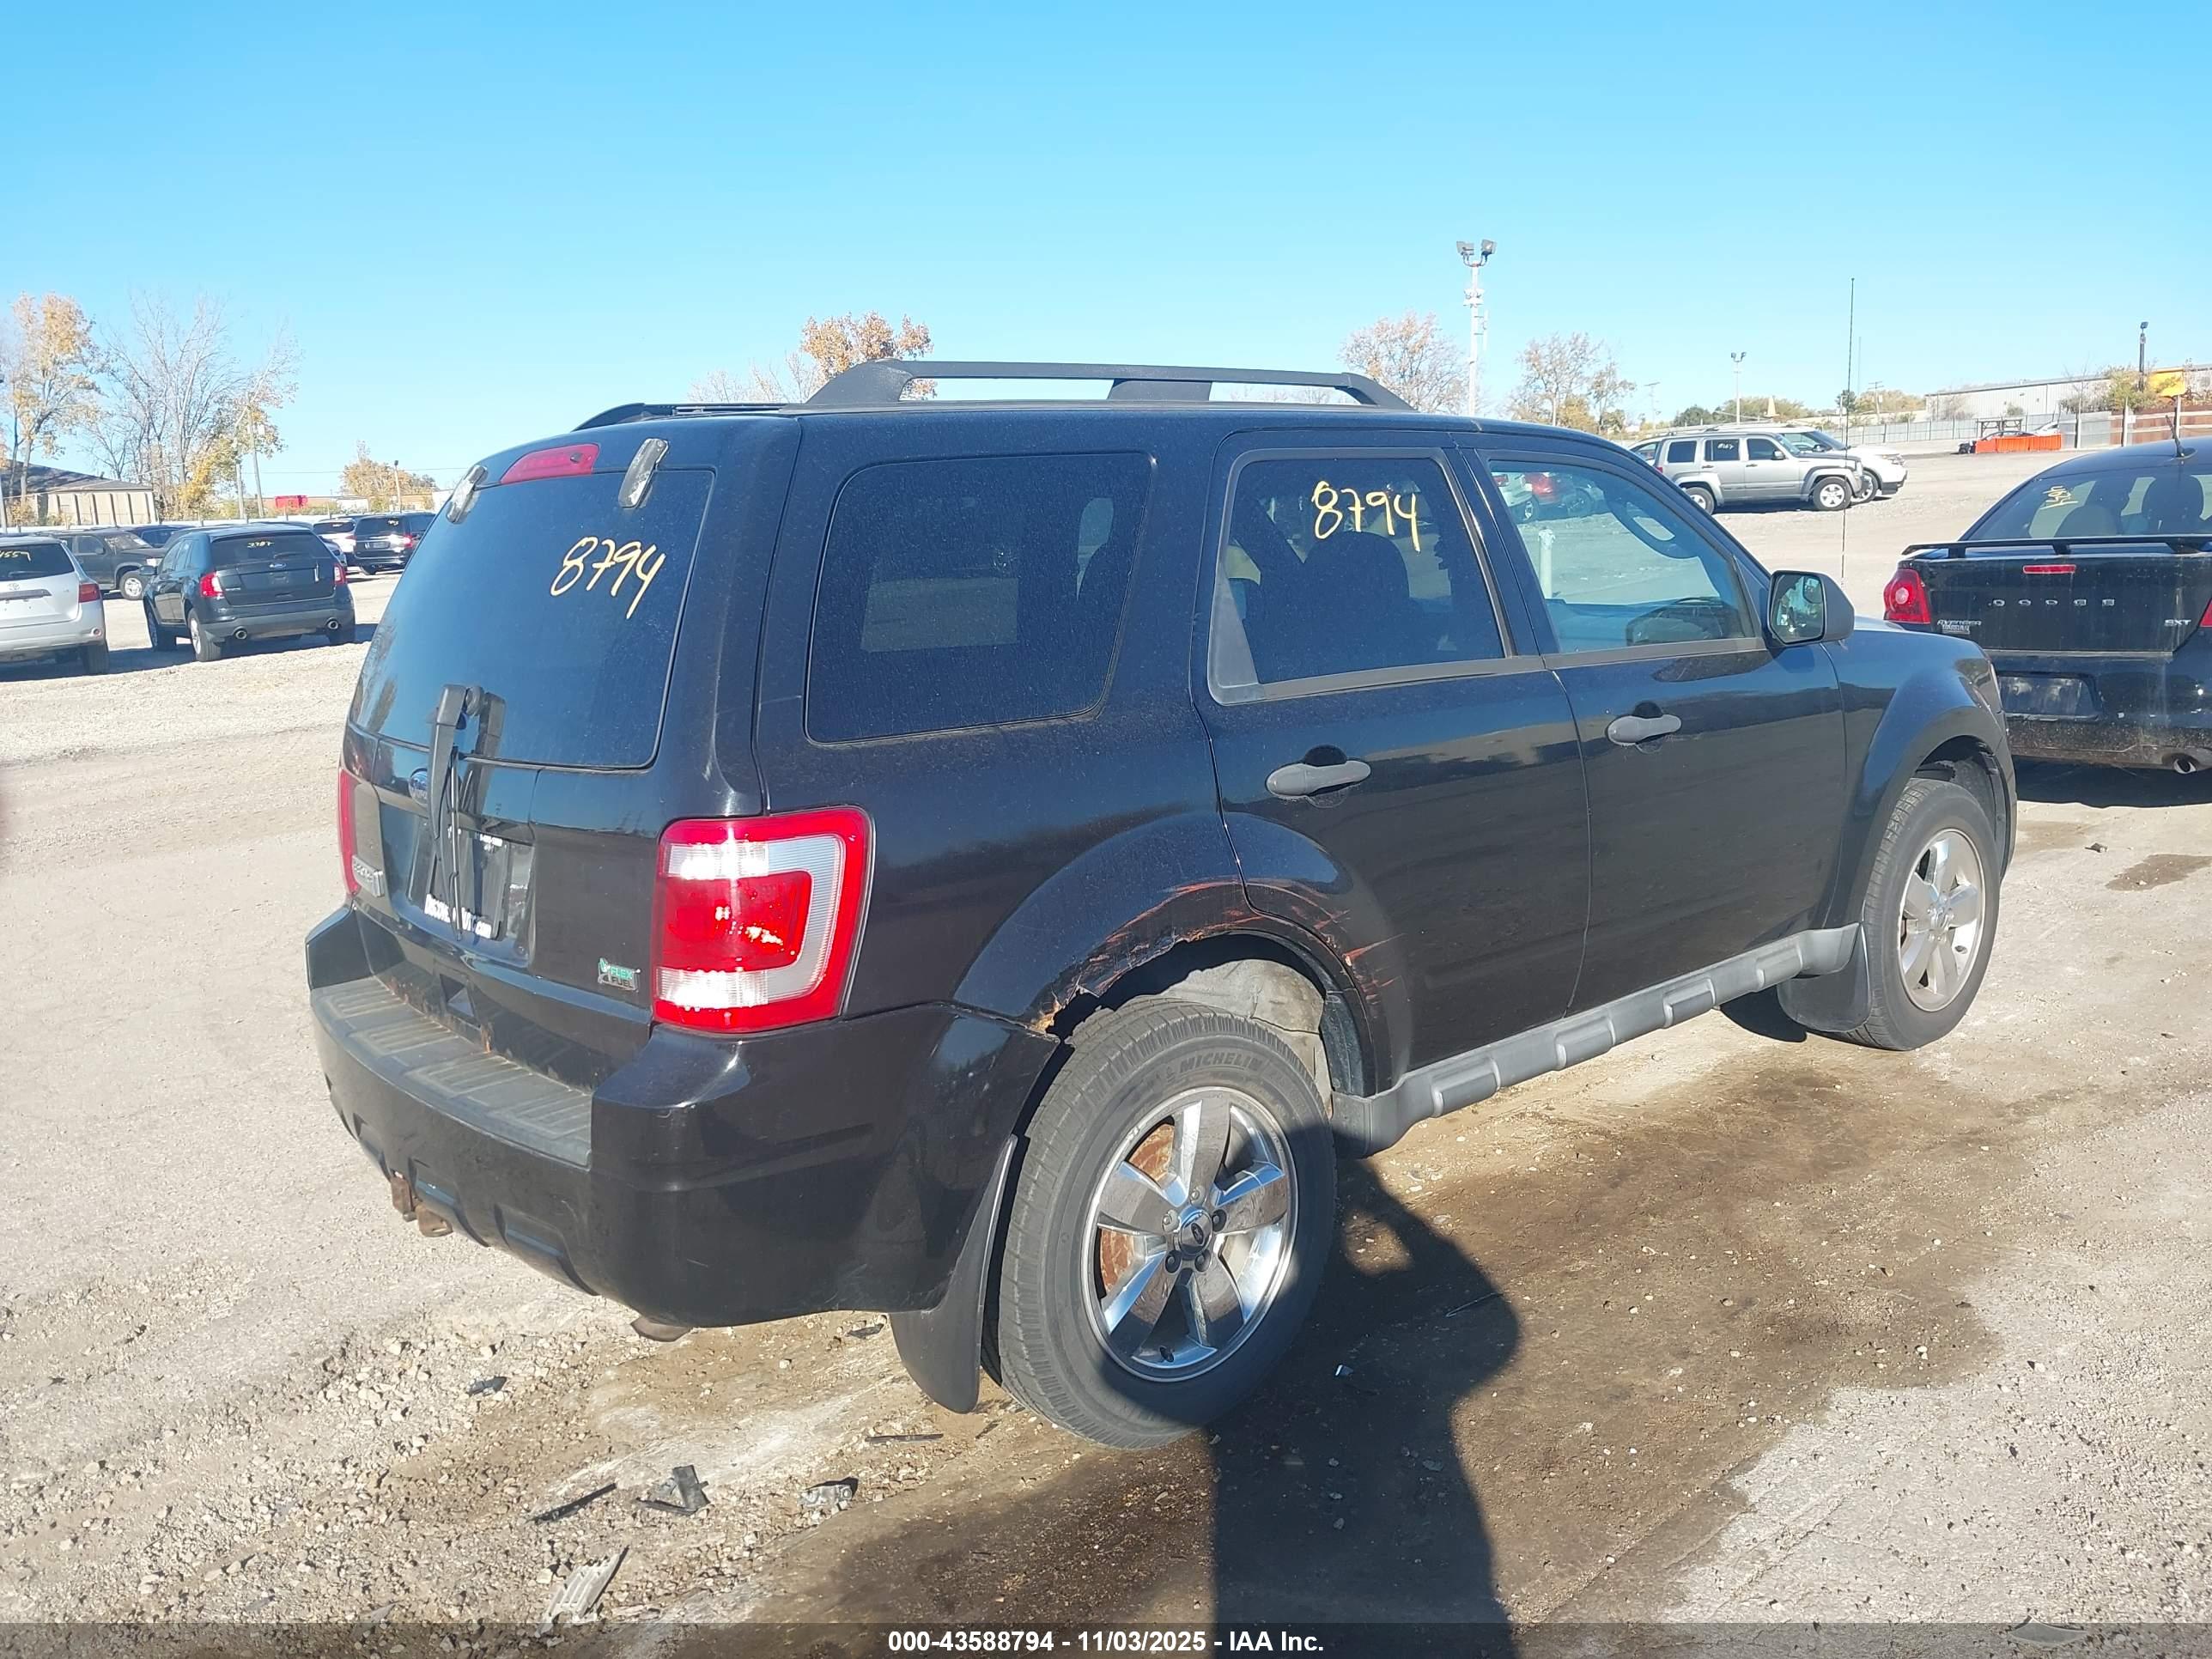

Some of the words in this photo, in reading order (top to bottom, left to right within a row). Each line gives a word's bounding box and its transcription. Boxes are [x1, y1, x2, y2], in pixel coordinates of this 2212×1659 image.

[1311, 480, 1421, 553] 8794
[550, 536, 666, 620] 8794
[1991, 599, 2116, 608] DODGE
[2164, 618, 2192, 627] SXT
[611, 964, 633, 980] FLEX
[1179, 1052, 1262, 1073] MICHELIN
